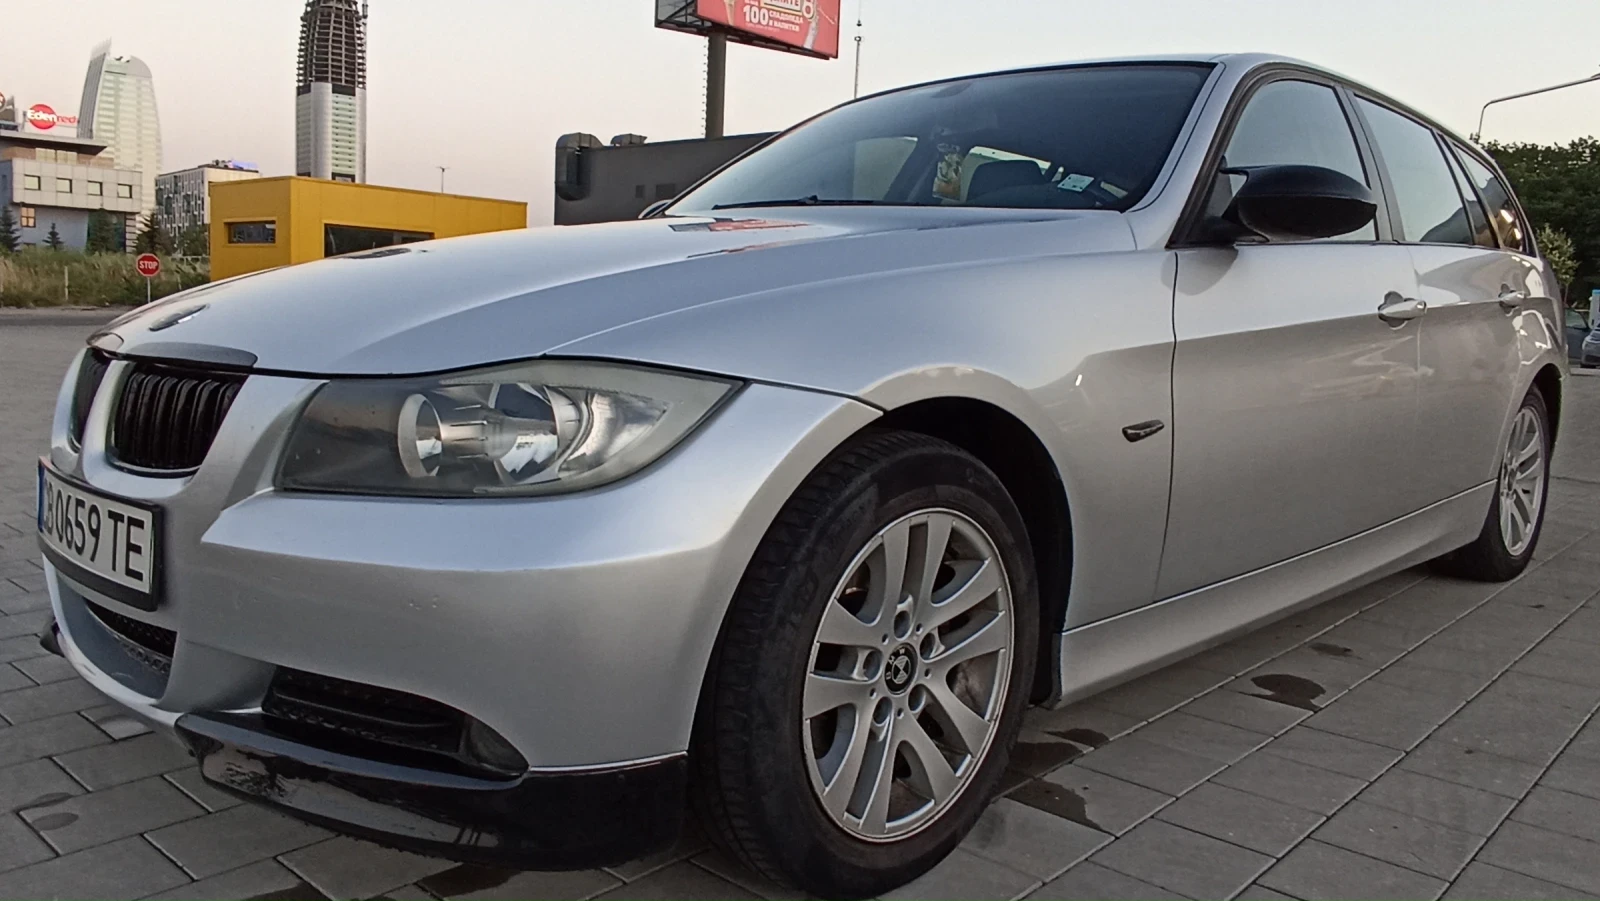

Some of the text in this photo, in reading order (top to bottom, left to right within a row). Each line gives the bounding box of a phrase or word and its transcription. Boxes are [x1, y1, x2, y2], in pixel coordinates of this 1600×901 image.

[743, 5, 769, 25] 100
[27, 109, 77, 124] Edenred
[139, 260, 158, 270] STOP
[107, 509, 145, 582] TE
